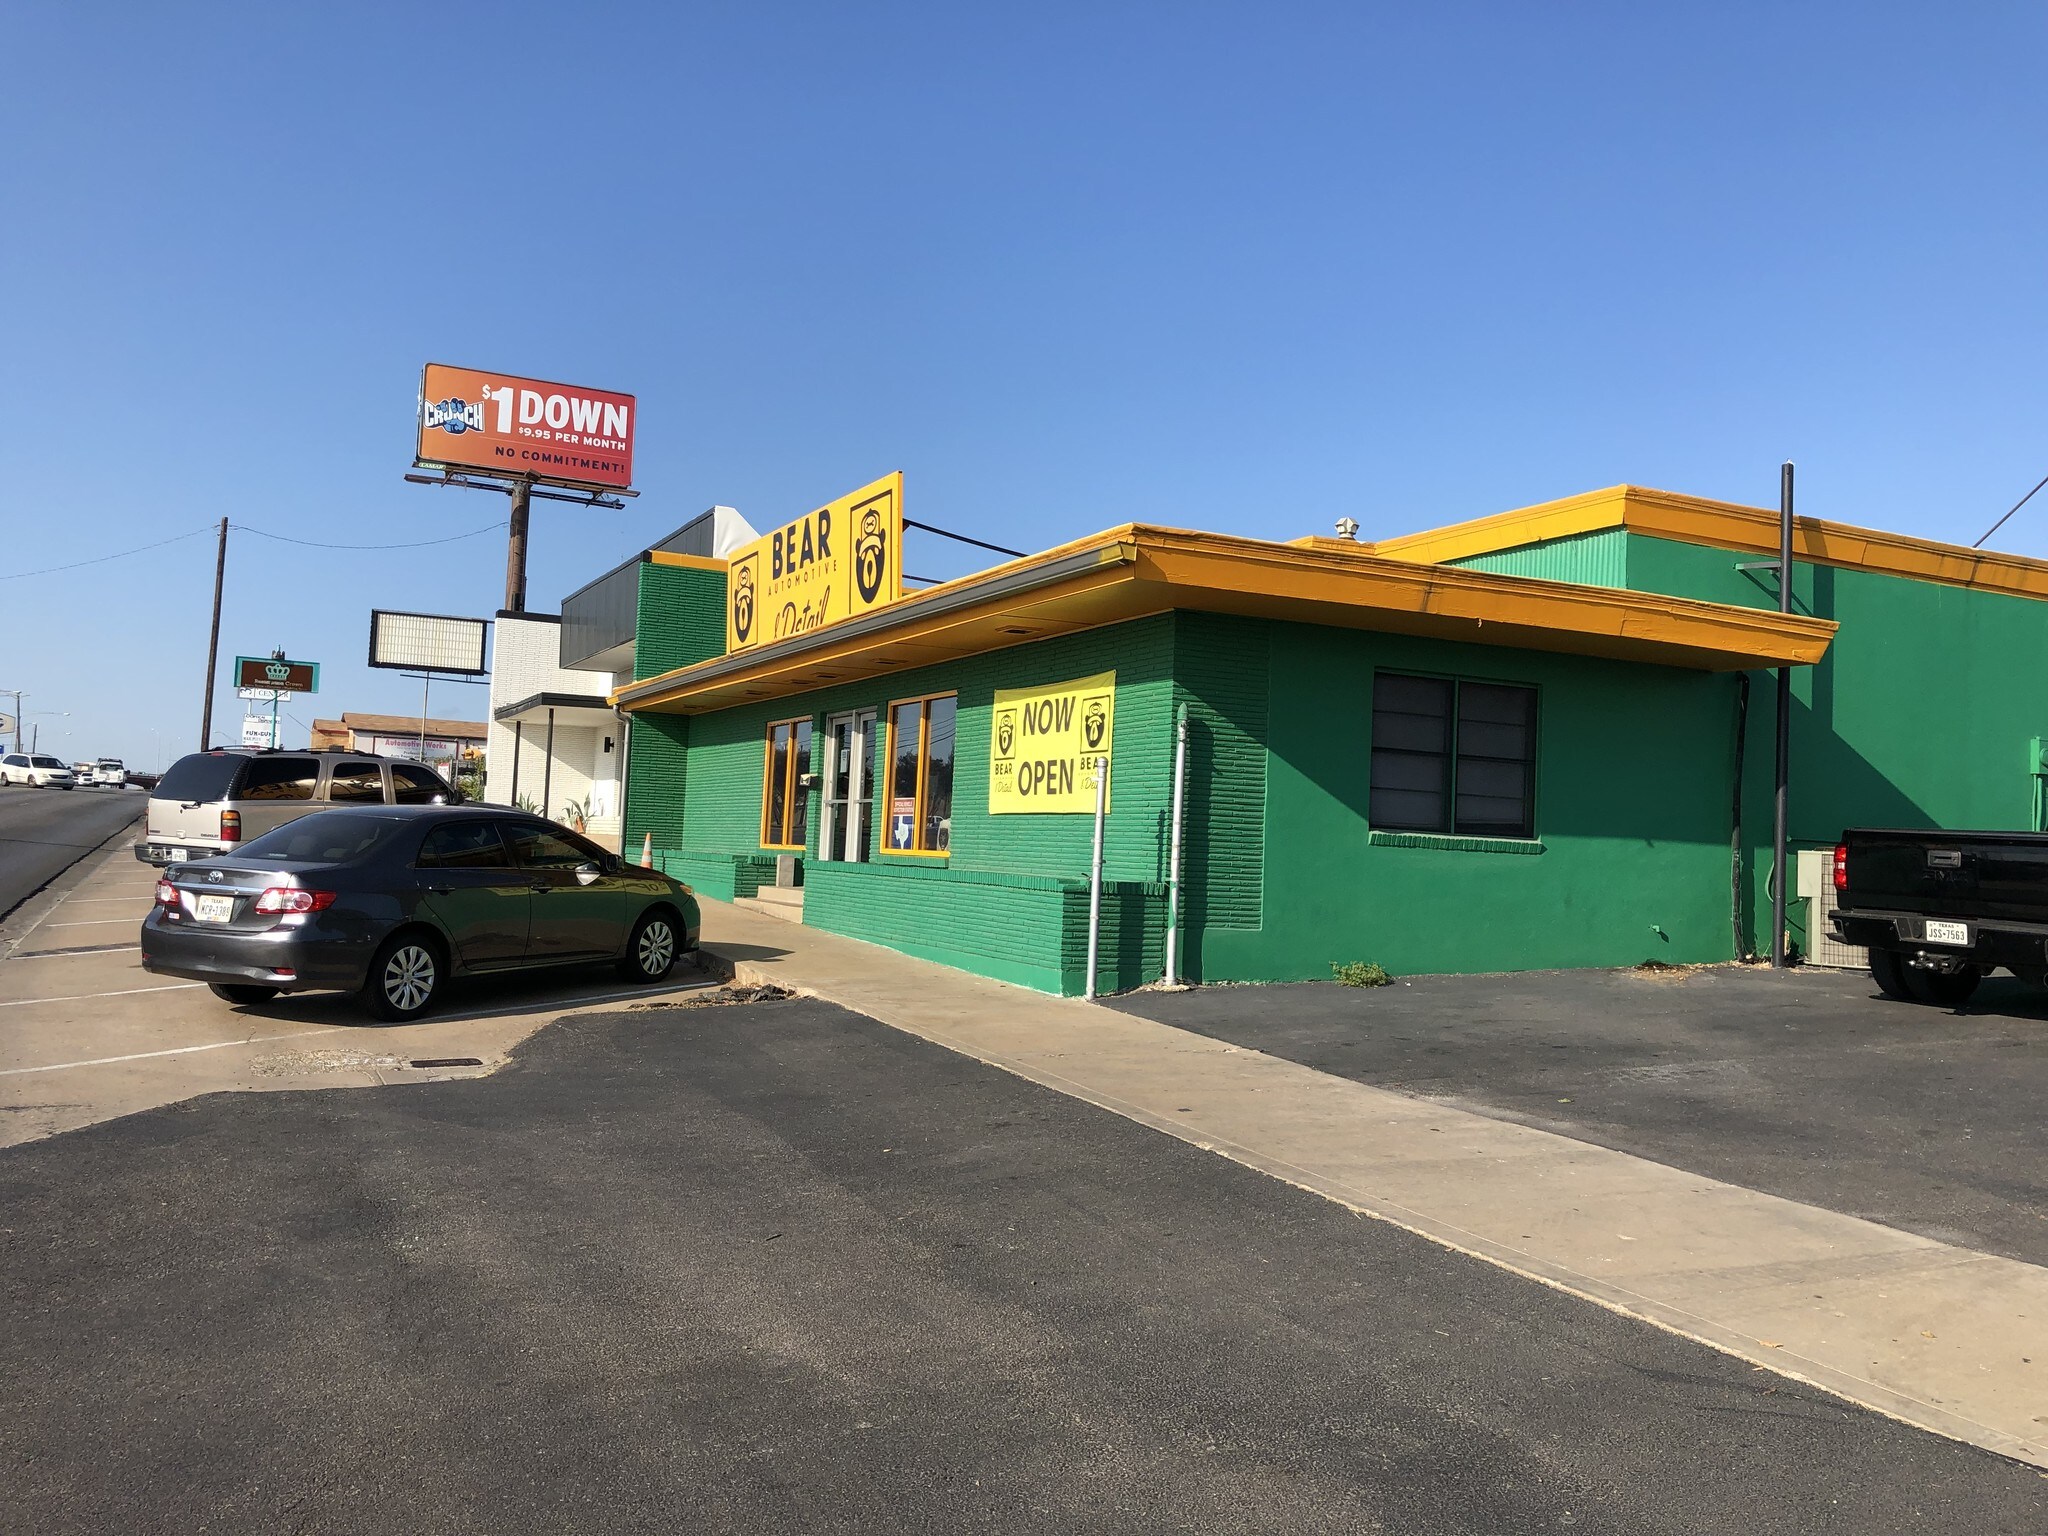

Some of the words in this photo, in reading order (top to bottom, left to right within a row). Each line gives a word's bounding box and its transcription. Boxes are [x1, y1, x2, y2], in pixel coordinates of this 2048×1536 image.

[424, 400, 484, 431] CRUNCH
[519, 390, 628, 439] DOWN
[518, 427, 551, 440] $9.95
[555, 432, 579, 444] PER
[583, 437, 626, 451] MONTH
[495, 446, 515, 457] NO
[521, 450, 625, 473] COMMITMENT!
[772, 508, 832, 581] BEAR
[768, 559, 837, 597] AUTOMOTIVE
[1023, 696, 1076, 736] NOW
[995, 763, 1013, 775] BEAR
[1018, 758, 1074, 796] OPEN
[1080, 757, 1098, 770] BEA
